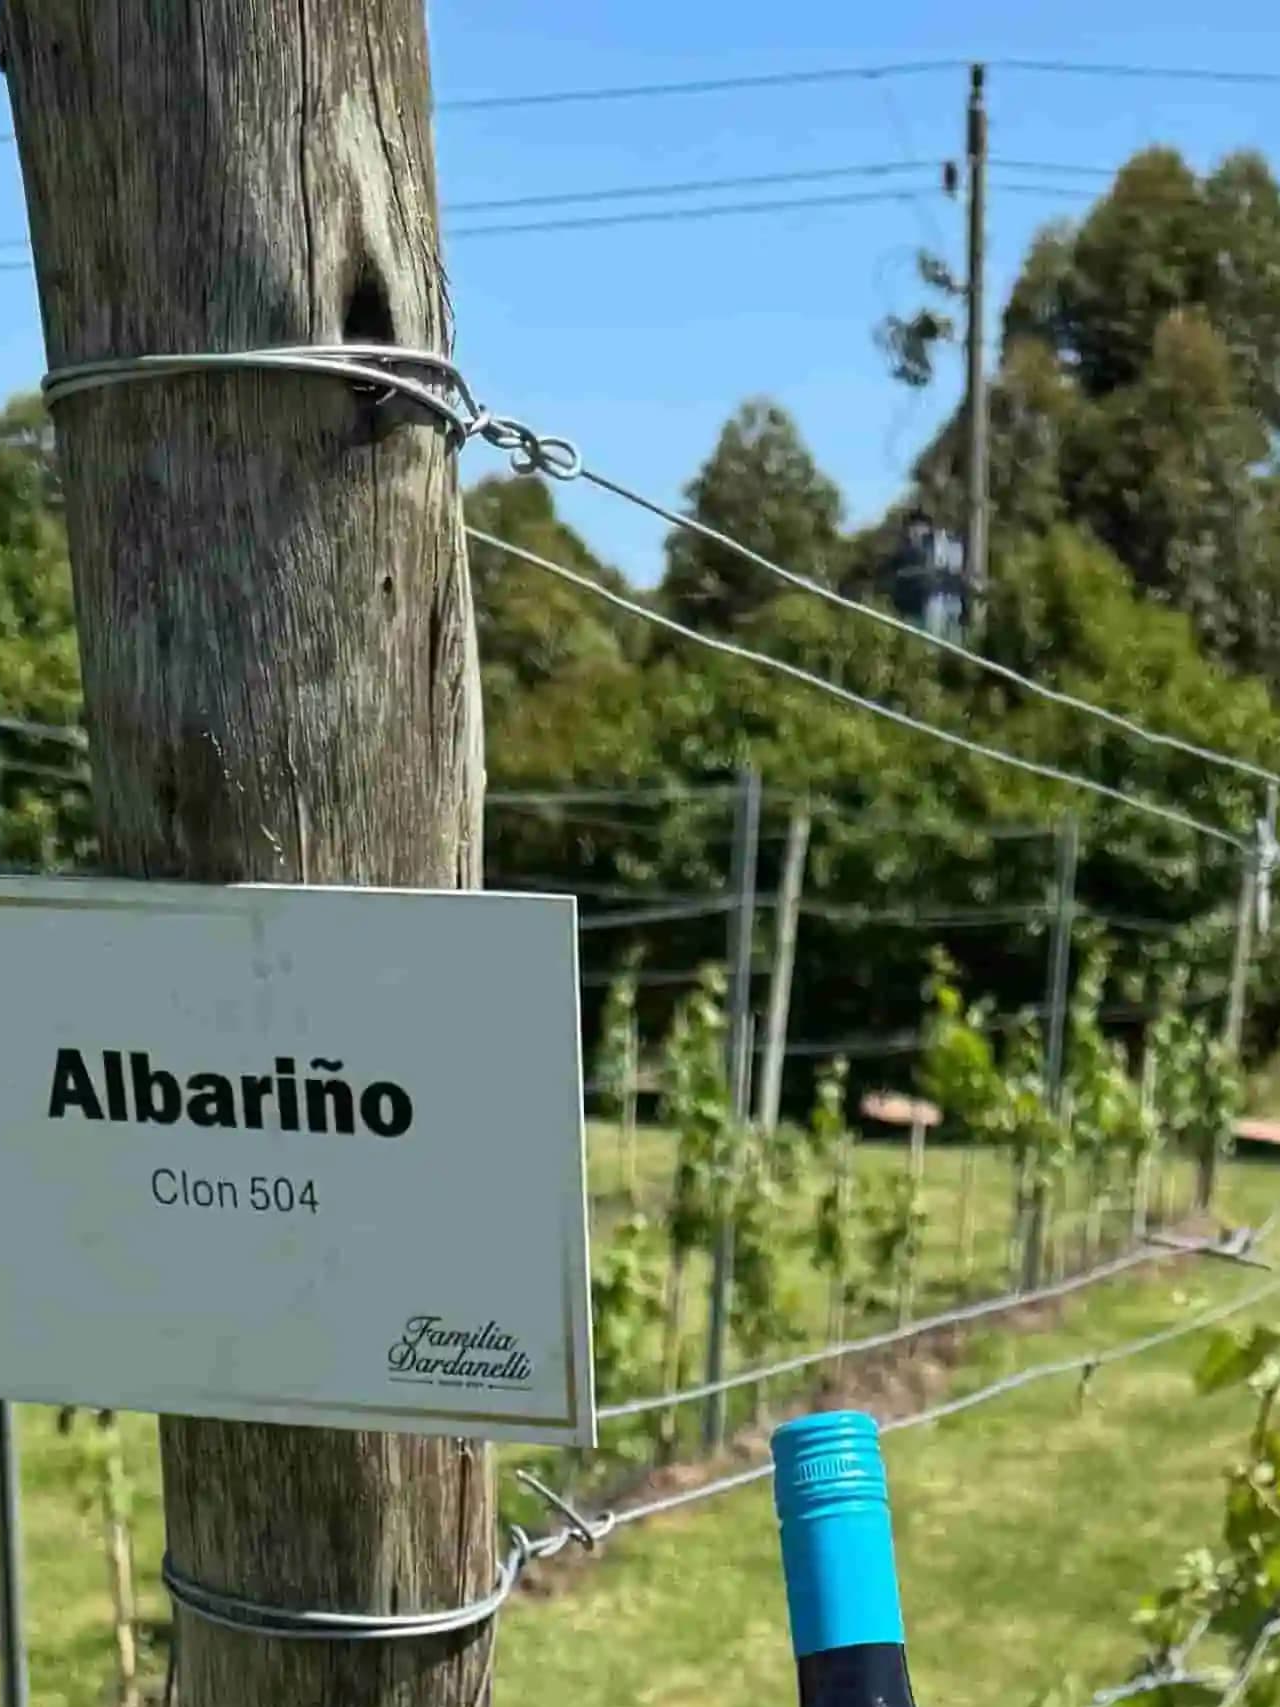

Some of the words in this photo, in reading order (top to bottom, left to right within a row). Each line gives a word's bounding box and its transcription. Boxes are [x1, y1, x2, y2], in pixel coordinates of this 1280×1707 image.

[48, 1047, 413, 1138] Albariño
[151, 1168, 238, 1208] Clon
[249, 1176, 320, 1214] 504
[403, 1316, 519, 1350] Familia
[388, 1342, 532, 1380] Dardanelli
